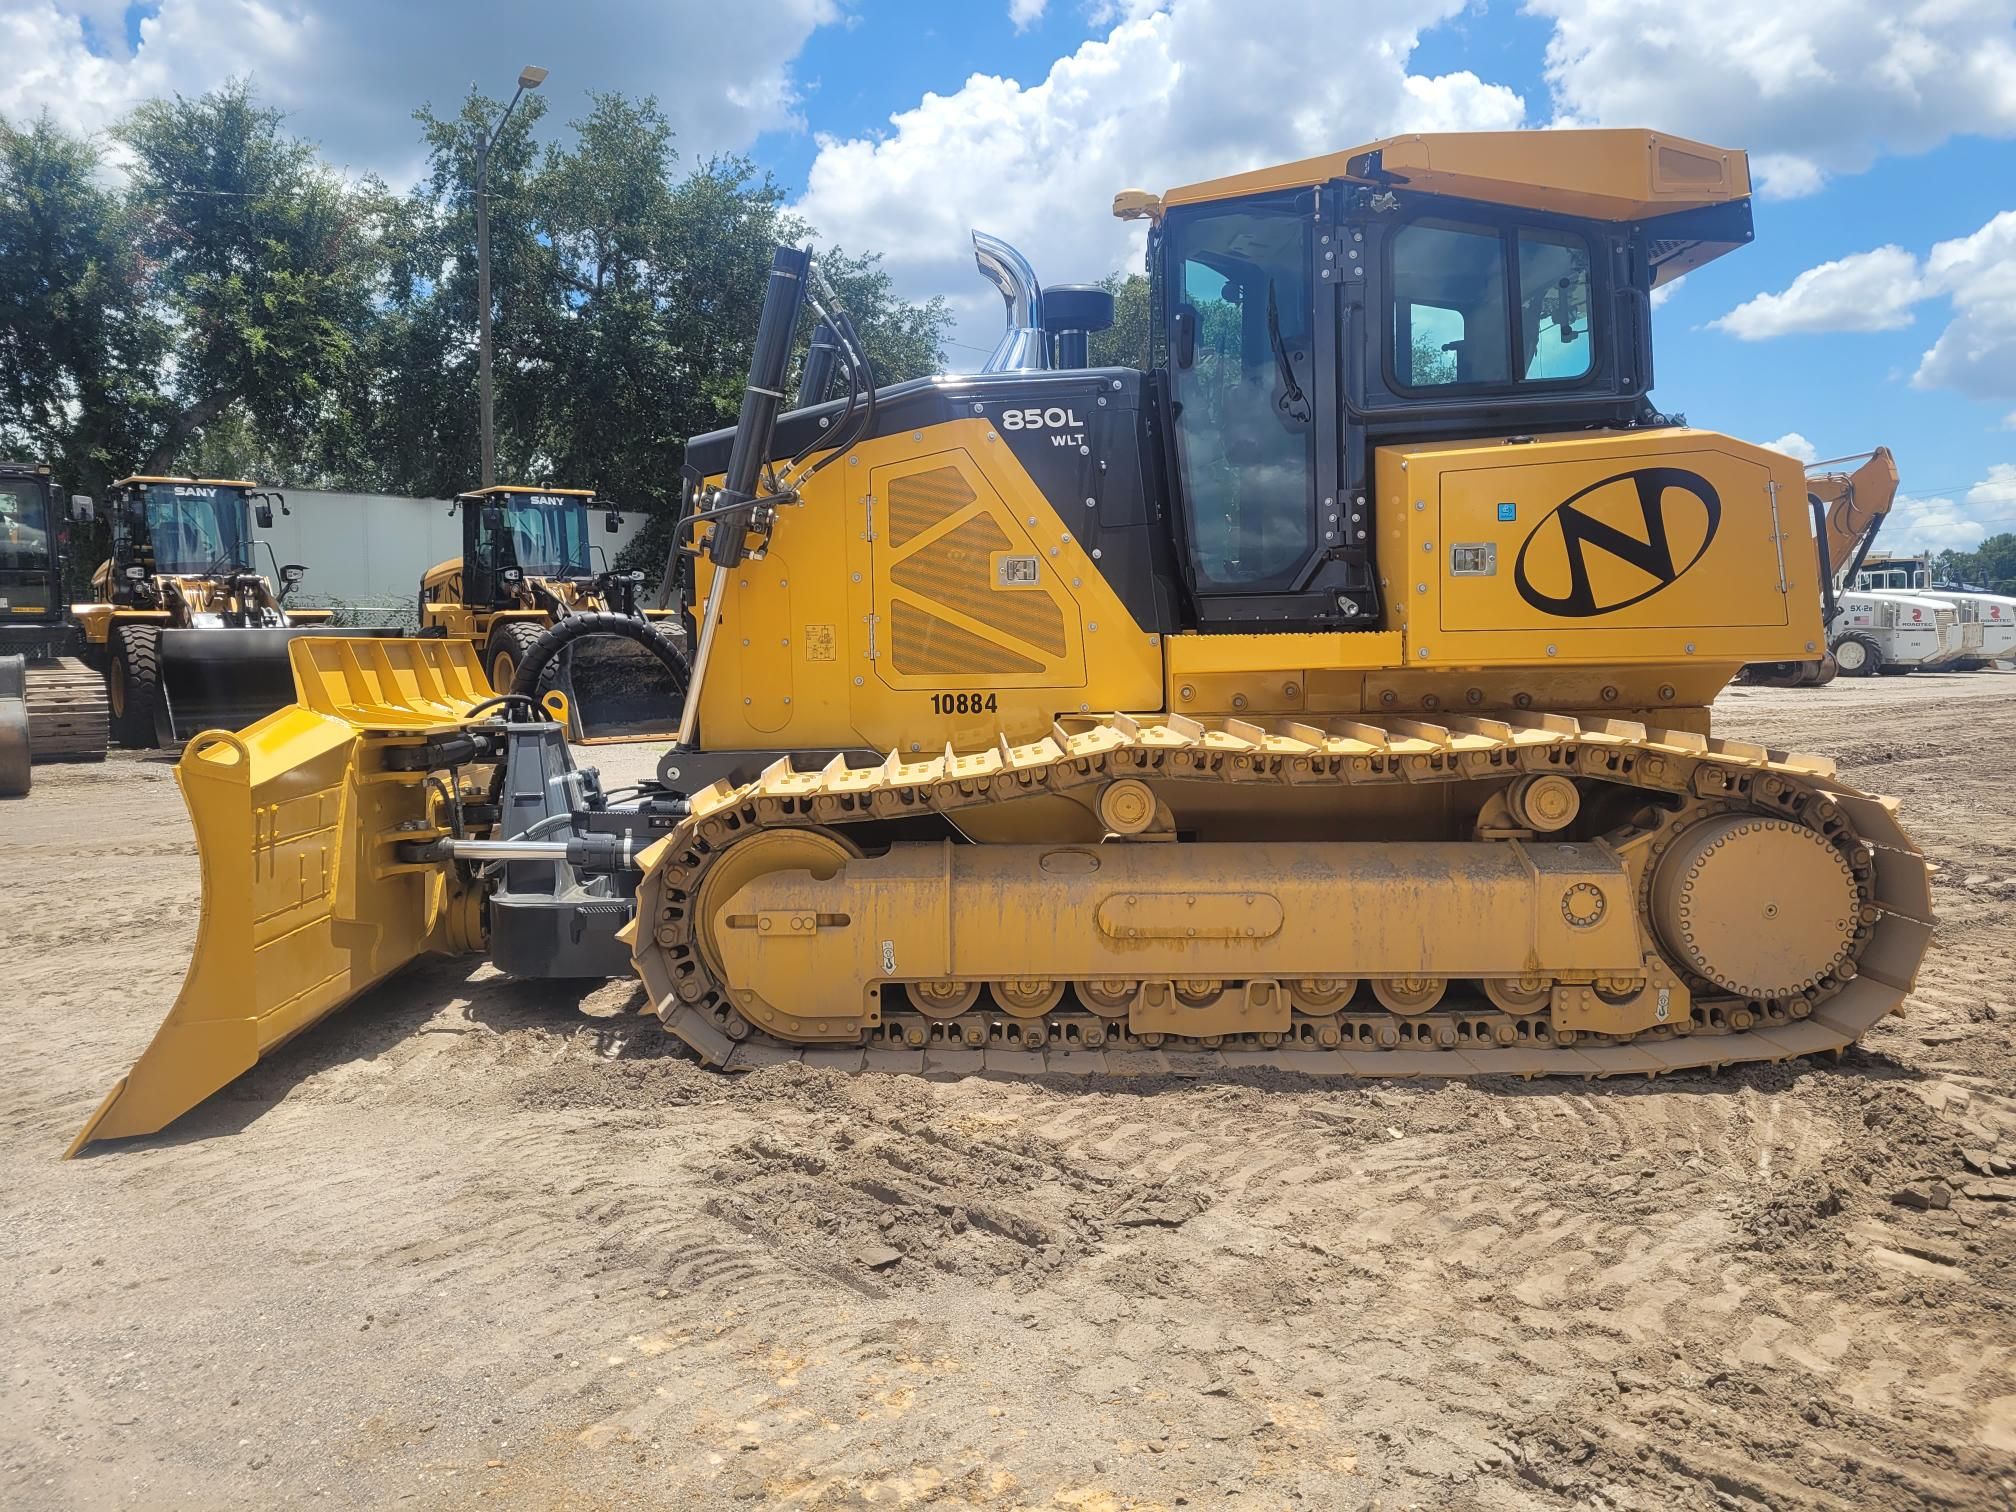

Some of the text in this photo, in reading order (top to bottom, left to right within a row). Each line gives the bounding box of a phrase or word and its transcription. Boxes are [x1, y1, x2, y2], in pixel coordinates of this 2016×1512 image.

[1002, 407, 1084, 430] 850L
[1051, 434, 1084, 447] WLT
[174, 486, 217, 497] SANY
[530, 496, 564, 506] SANY
[930, 693, 998, 715] 10884
